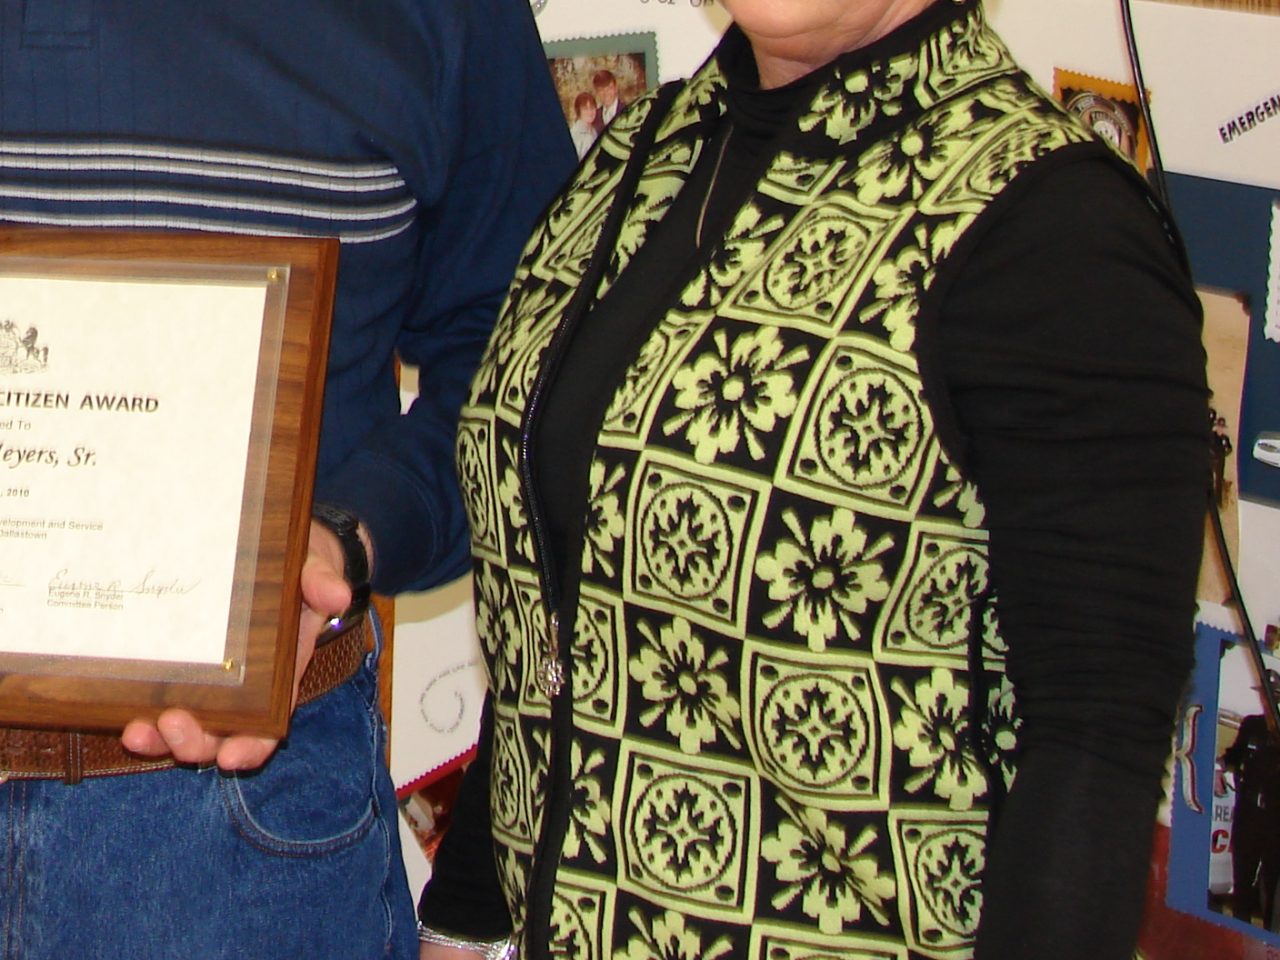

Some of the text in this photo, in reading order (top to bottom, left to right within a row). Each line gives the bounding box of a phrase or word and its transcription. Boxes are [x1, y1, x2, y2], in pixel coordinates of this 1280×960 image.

[79, 394, 160, 414] AWARD
[17, 419, 32, 431] To
[66, 446, 97, 467] Sr.
[6, 488, 30, 498] 2010
[48, 520, 66, 529] and
[68, 521, 103, 531] Service
